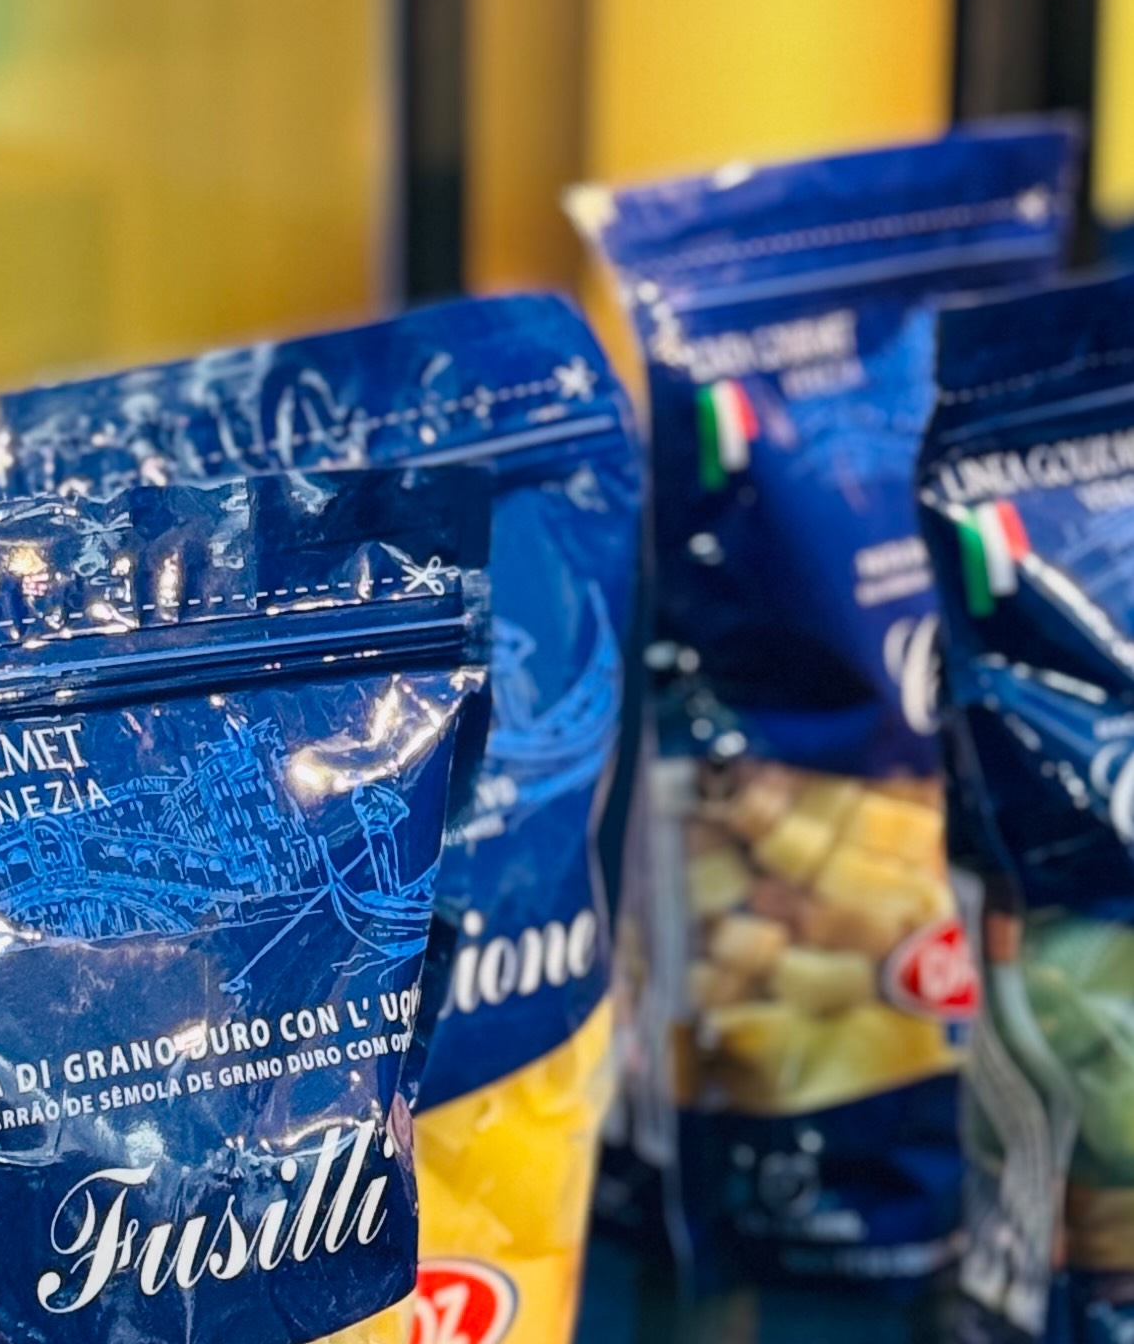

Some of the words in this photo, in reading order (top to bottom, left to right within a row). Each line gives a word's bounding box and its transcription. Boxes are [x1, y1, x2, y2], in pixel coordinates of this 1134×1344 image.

[16, 1059, 51, 1093] DI
[63, 1036, 175, 1084] GRANO
[189, 1018, 270, 1060] DURO
[279, 1004, 340, 1042] CON
[346, 997, 369, 1029] L'
[66, 1094, 93, 1118] DE
[97, 1077, 182, 1112] SÊMOLA
[187, 1071, 215, 1094] DE
[218, 1059, 283, 1087] GRANO
[287, 1046, 342, 1074] DURO
[346, 1036, 389, 1061] COM
[36, 1119, 394, 1314] Fusilli
